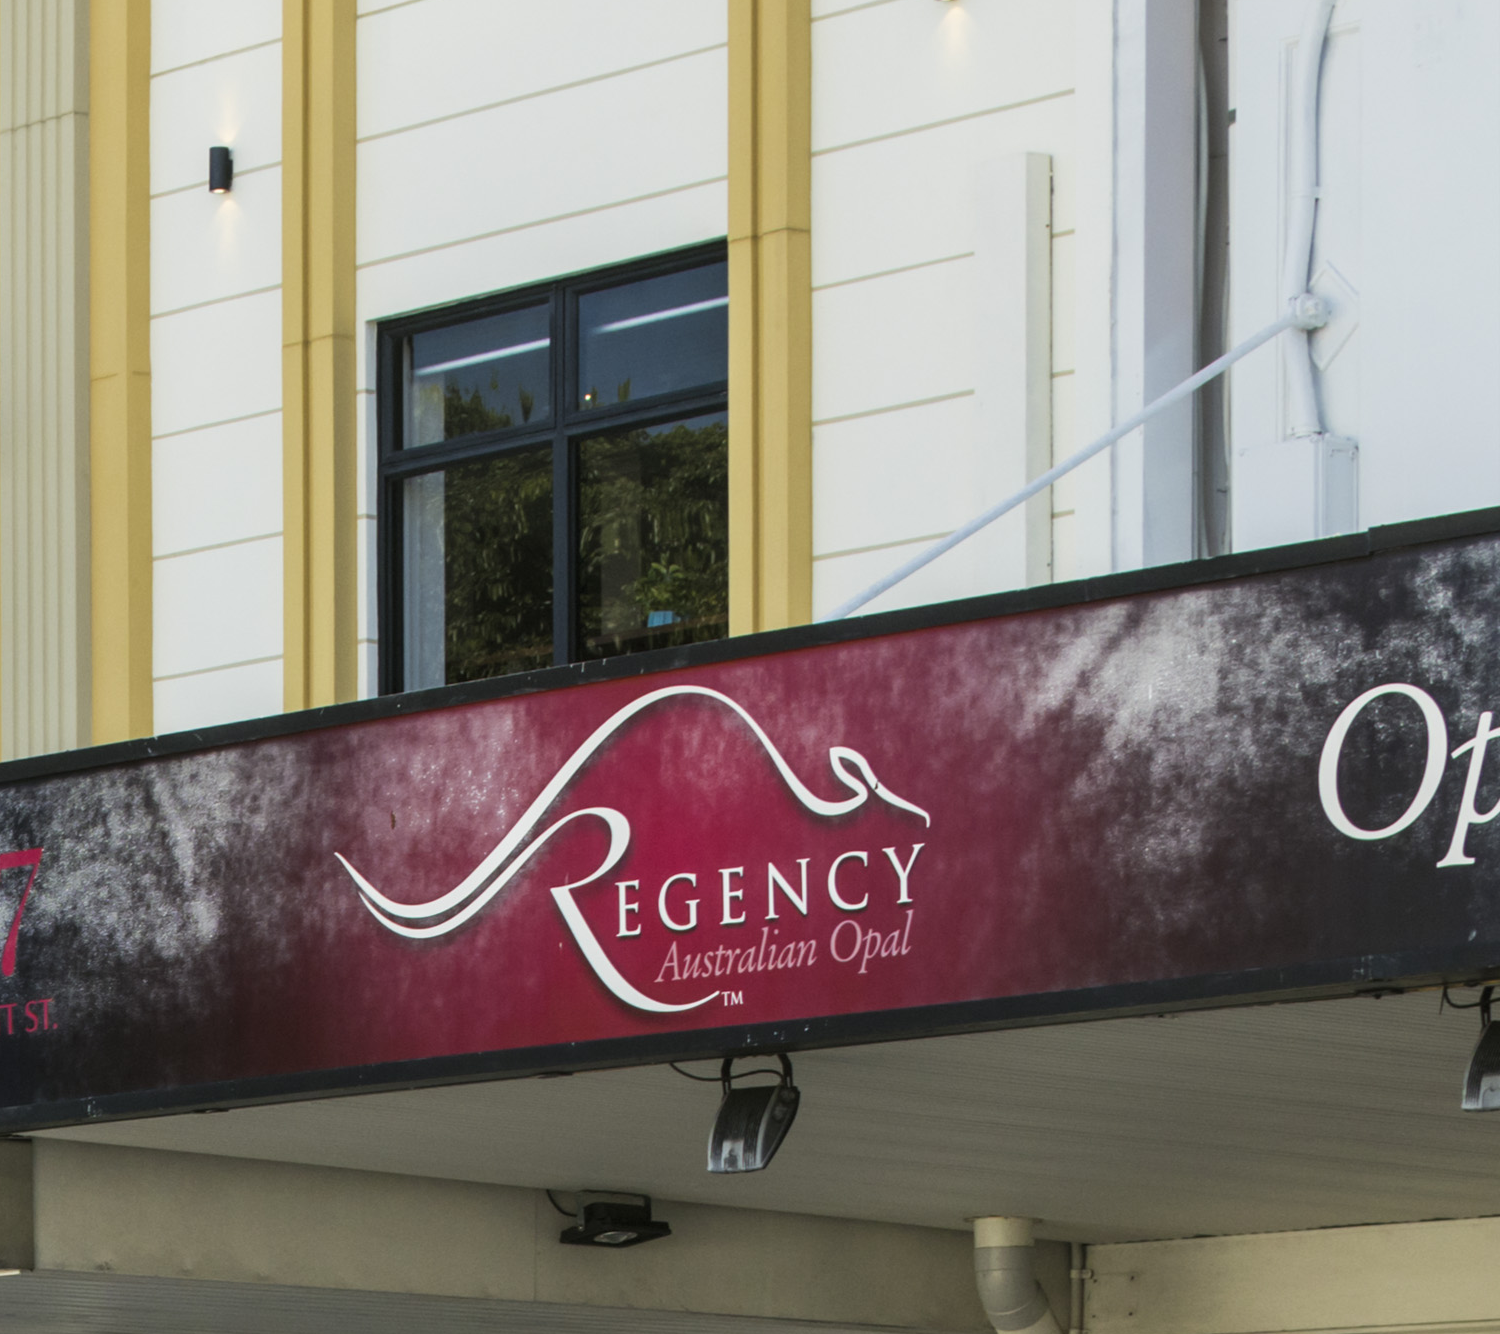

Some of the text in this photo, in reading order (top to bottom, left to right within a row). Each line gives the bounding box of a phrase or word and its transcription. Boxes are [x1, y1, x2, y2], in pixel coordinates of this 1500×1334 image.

[655, 909, 915, 984] Australian Opal
[24, 997, 60, 1036] ST.
